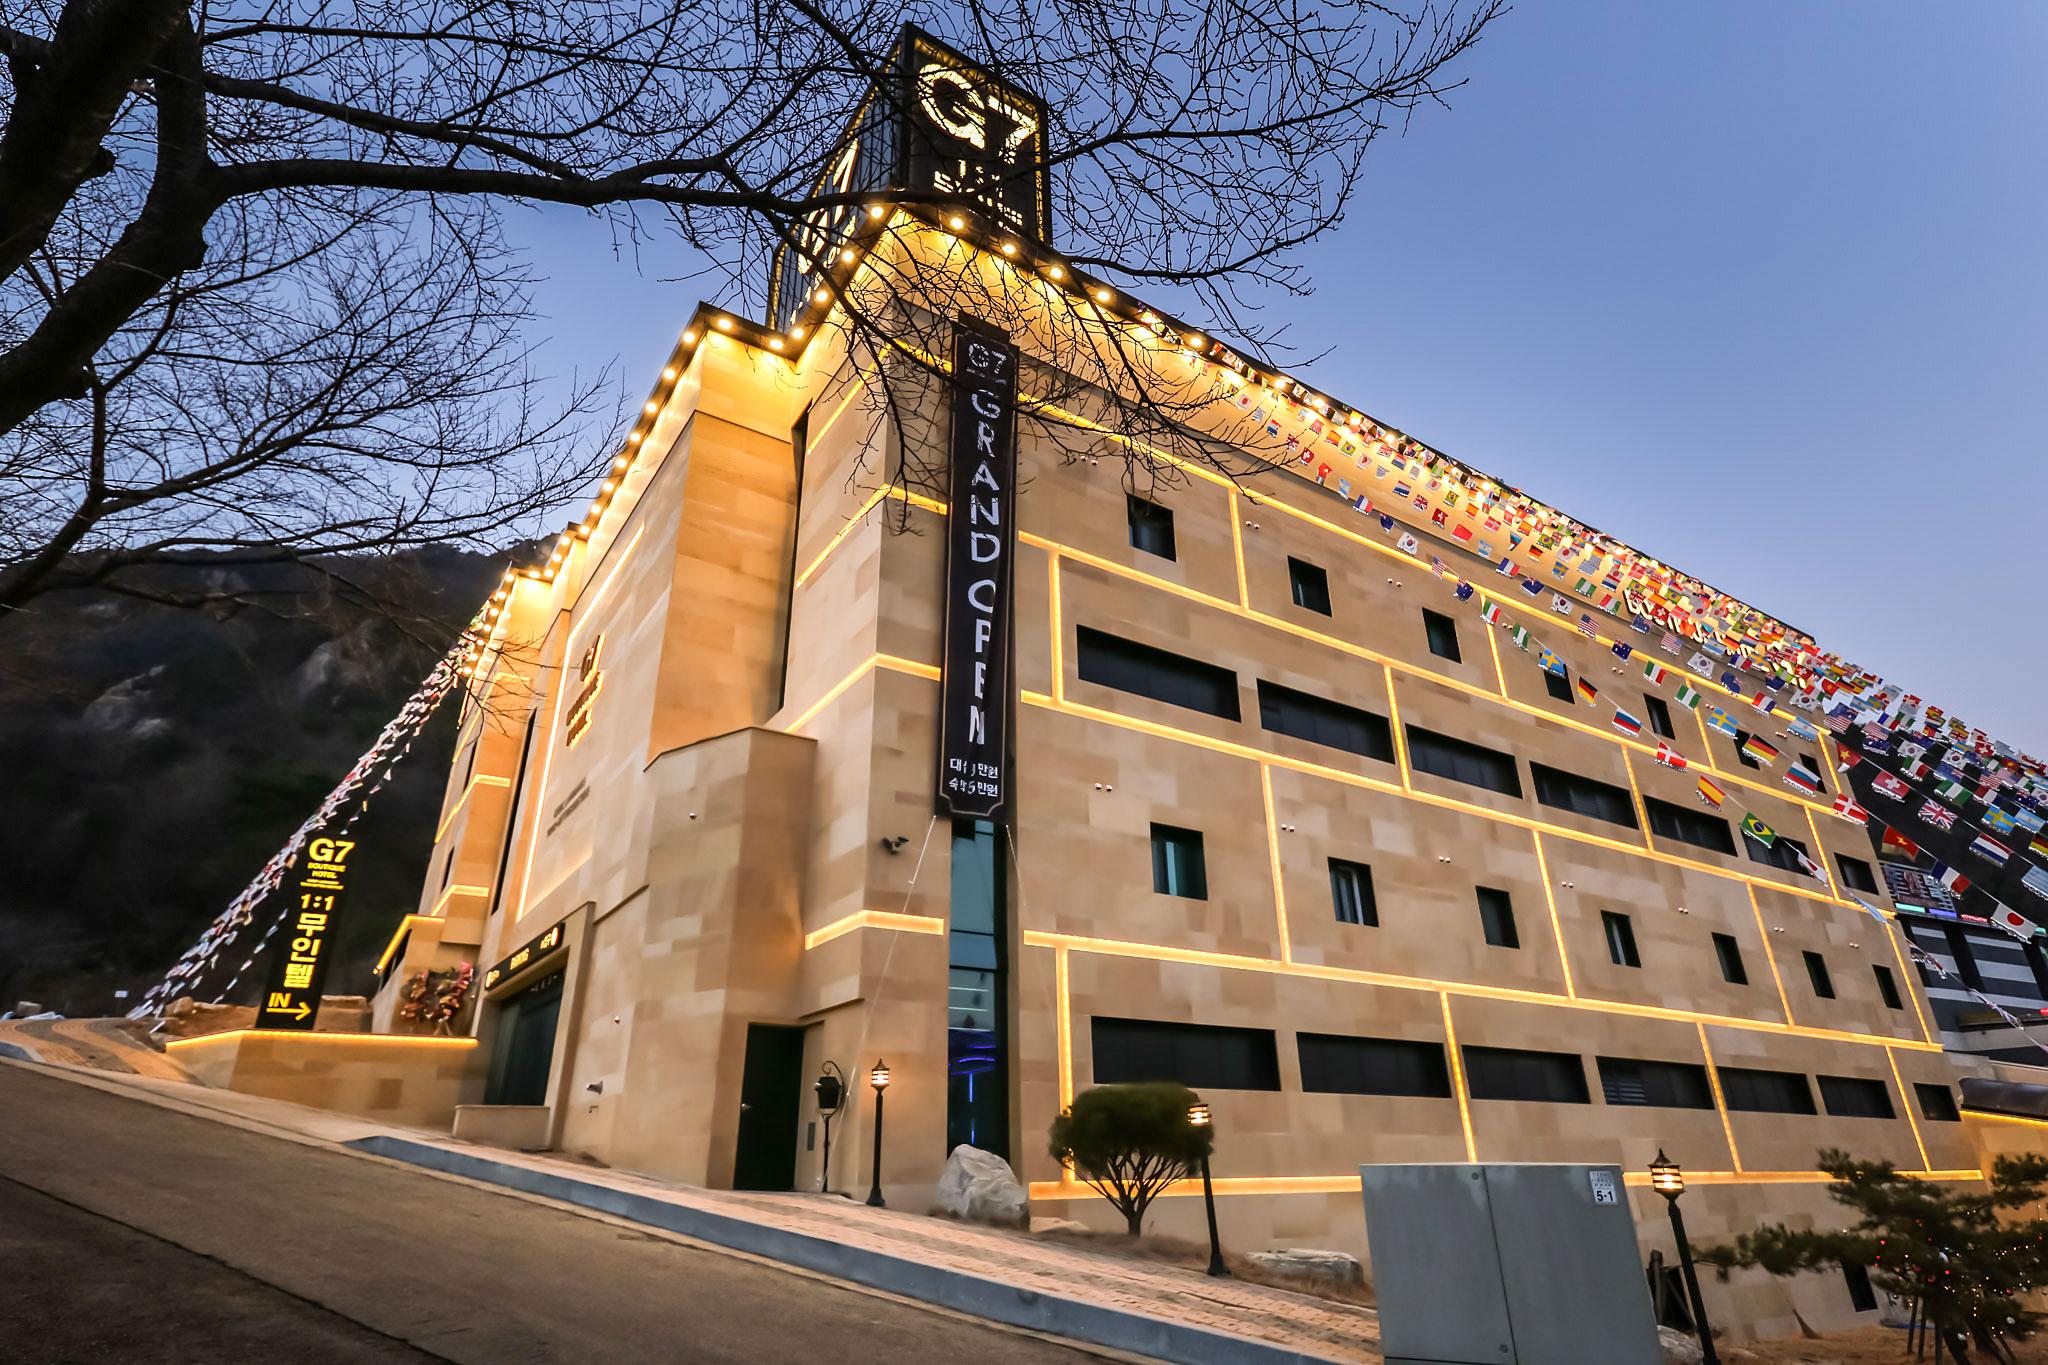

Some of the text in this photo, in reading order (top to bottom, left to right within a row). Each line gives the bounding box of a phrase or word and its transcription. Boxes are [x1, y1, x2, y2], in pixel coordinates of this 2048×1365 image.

[917, 63, 1039, 165] G7
[968, 343, 1007, 375] G7
[971, 389, 1001, 563] GRAND
[967, 579, 997, 745] OPEN
[308, 837, 356, 863] G7
[300, 893, 335, 911] 1:1
[283, 913, 328, 989] 무인텔
[267, 992, 292, 1008] IN
[1596, 1190, 1614, 1202] 5-1
